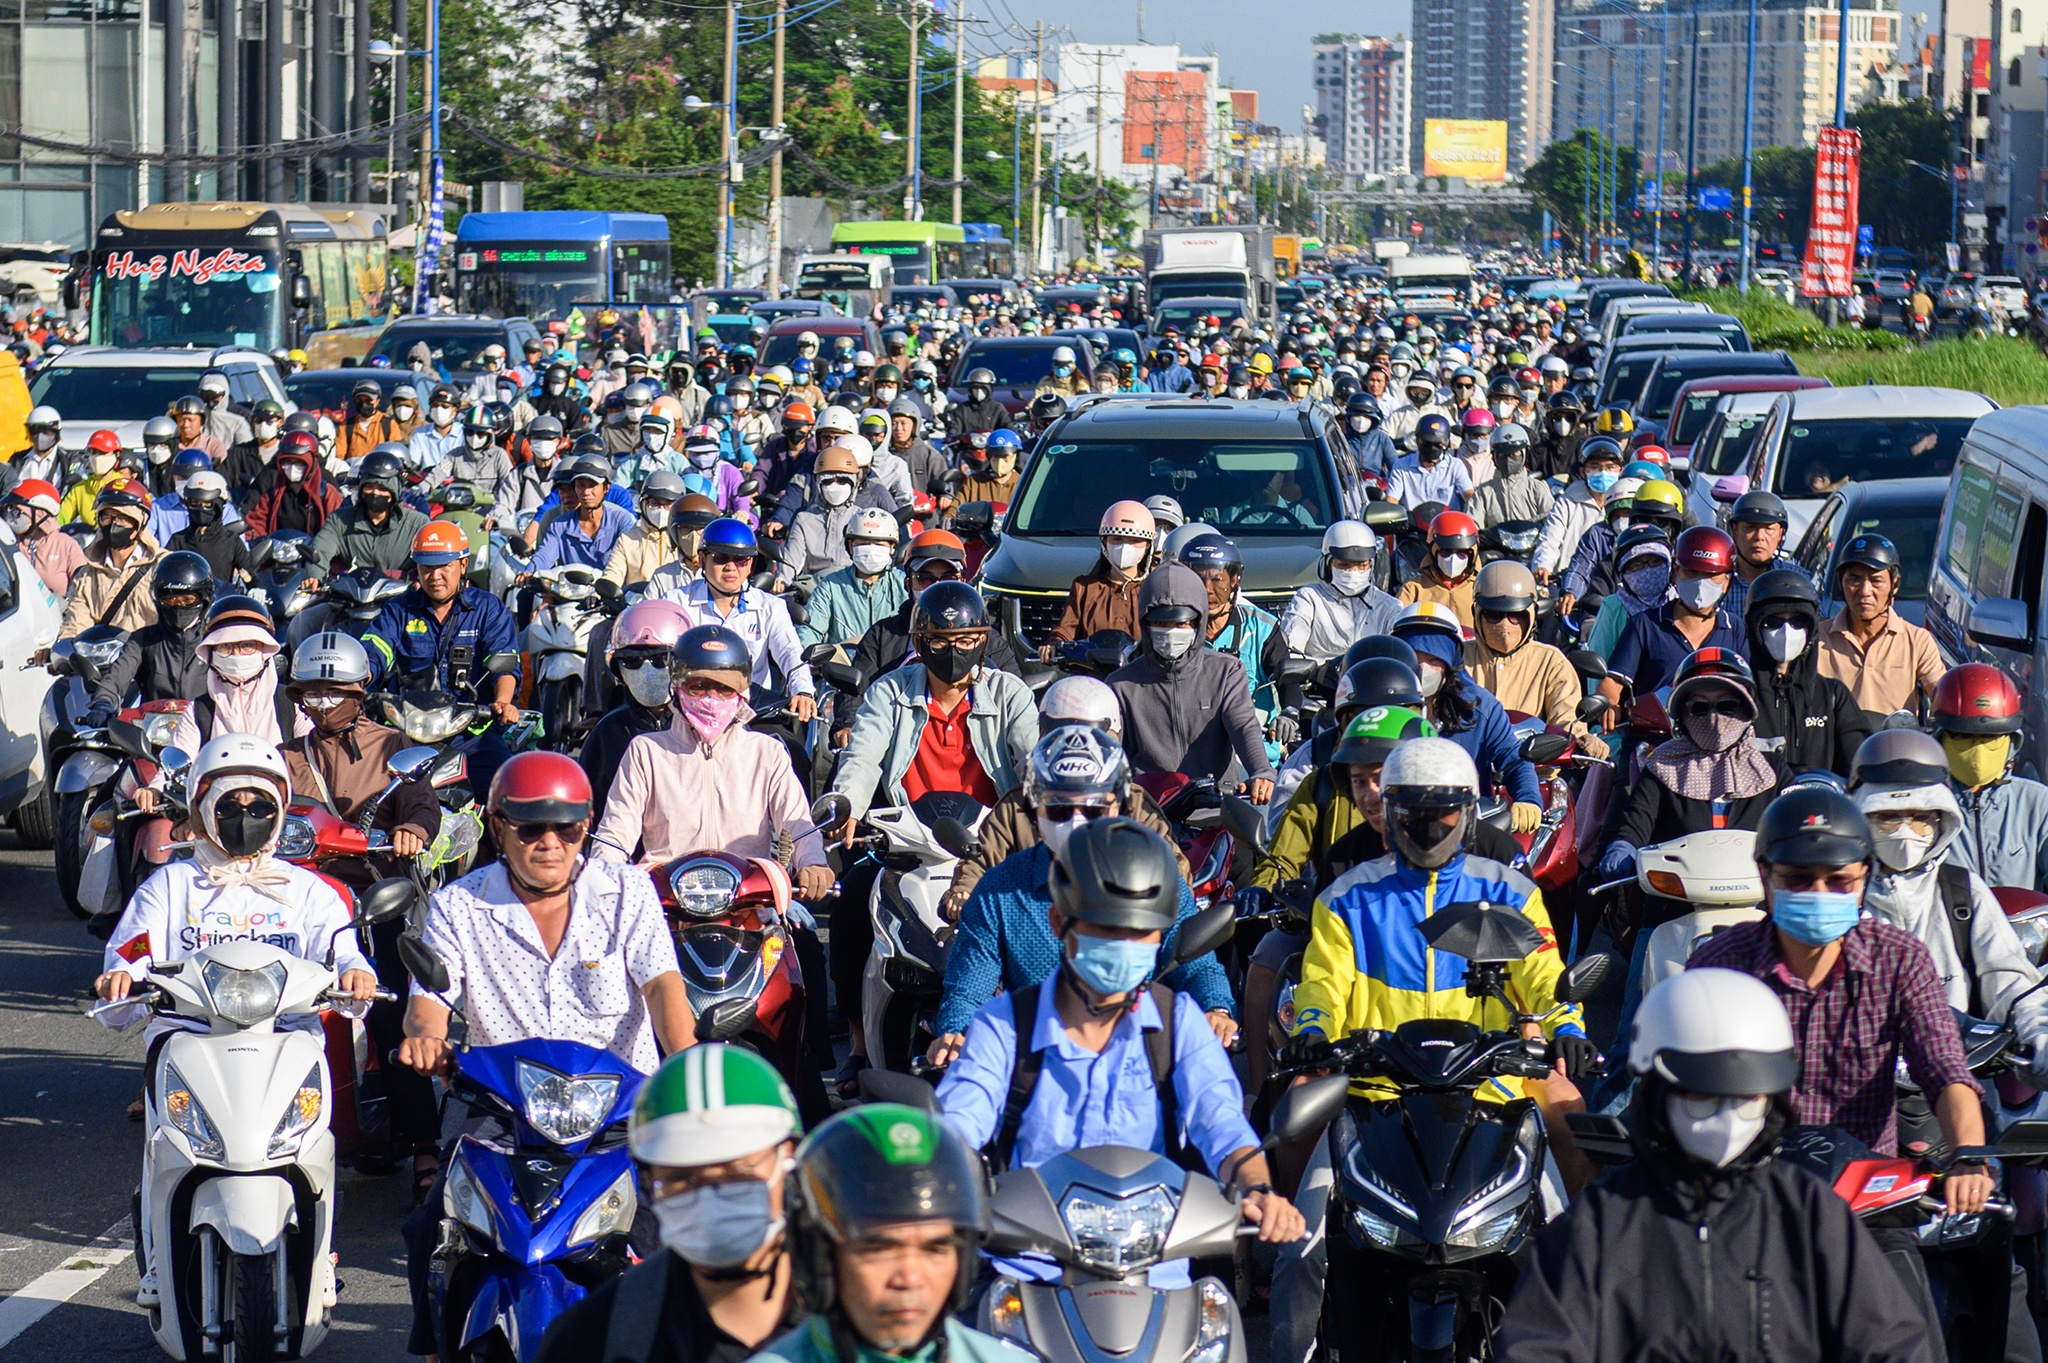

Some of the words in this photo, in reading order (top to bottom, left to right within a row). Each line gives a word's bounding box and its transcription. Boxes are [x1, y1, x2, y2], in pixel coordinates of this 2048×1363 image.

[106, 251, 167, 280] Huệ
[170, 247, 266, 285] Nghĩa
[1805, 716, 1825, 728] BYC
[1057, 762, 1091, 772] NHK
[1709, 884, 1751, 892] HONDA
[186, 901, 281, 933] Crayon
[1087, 1289, 1138, 1298] HONDA
